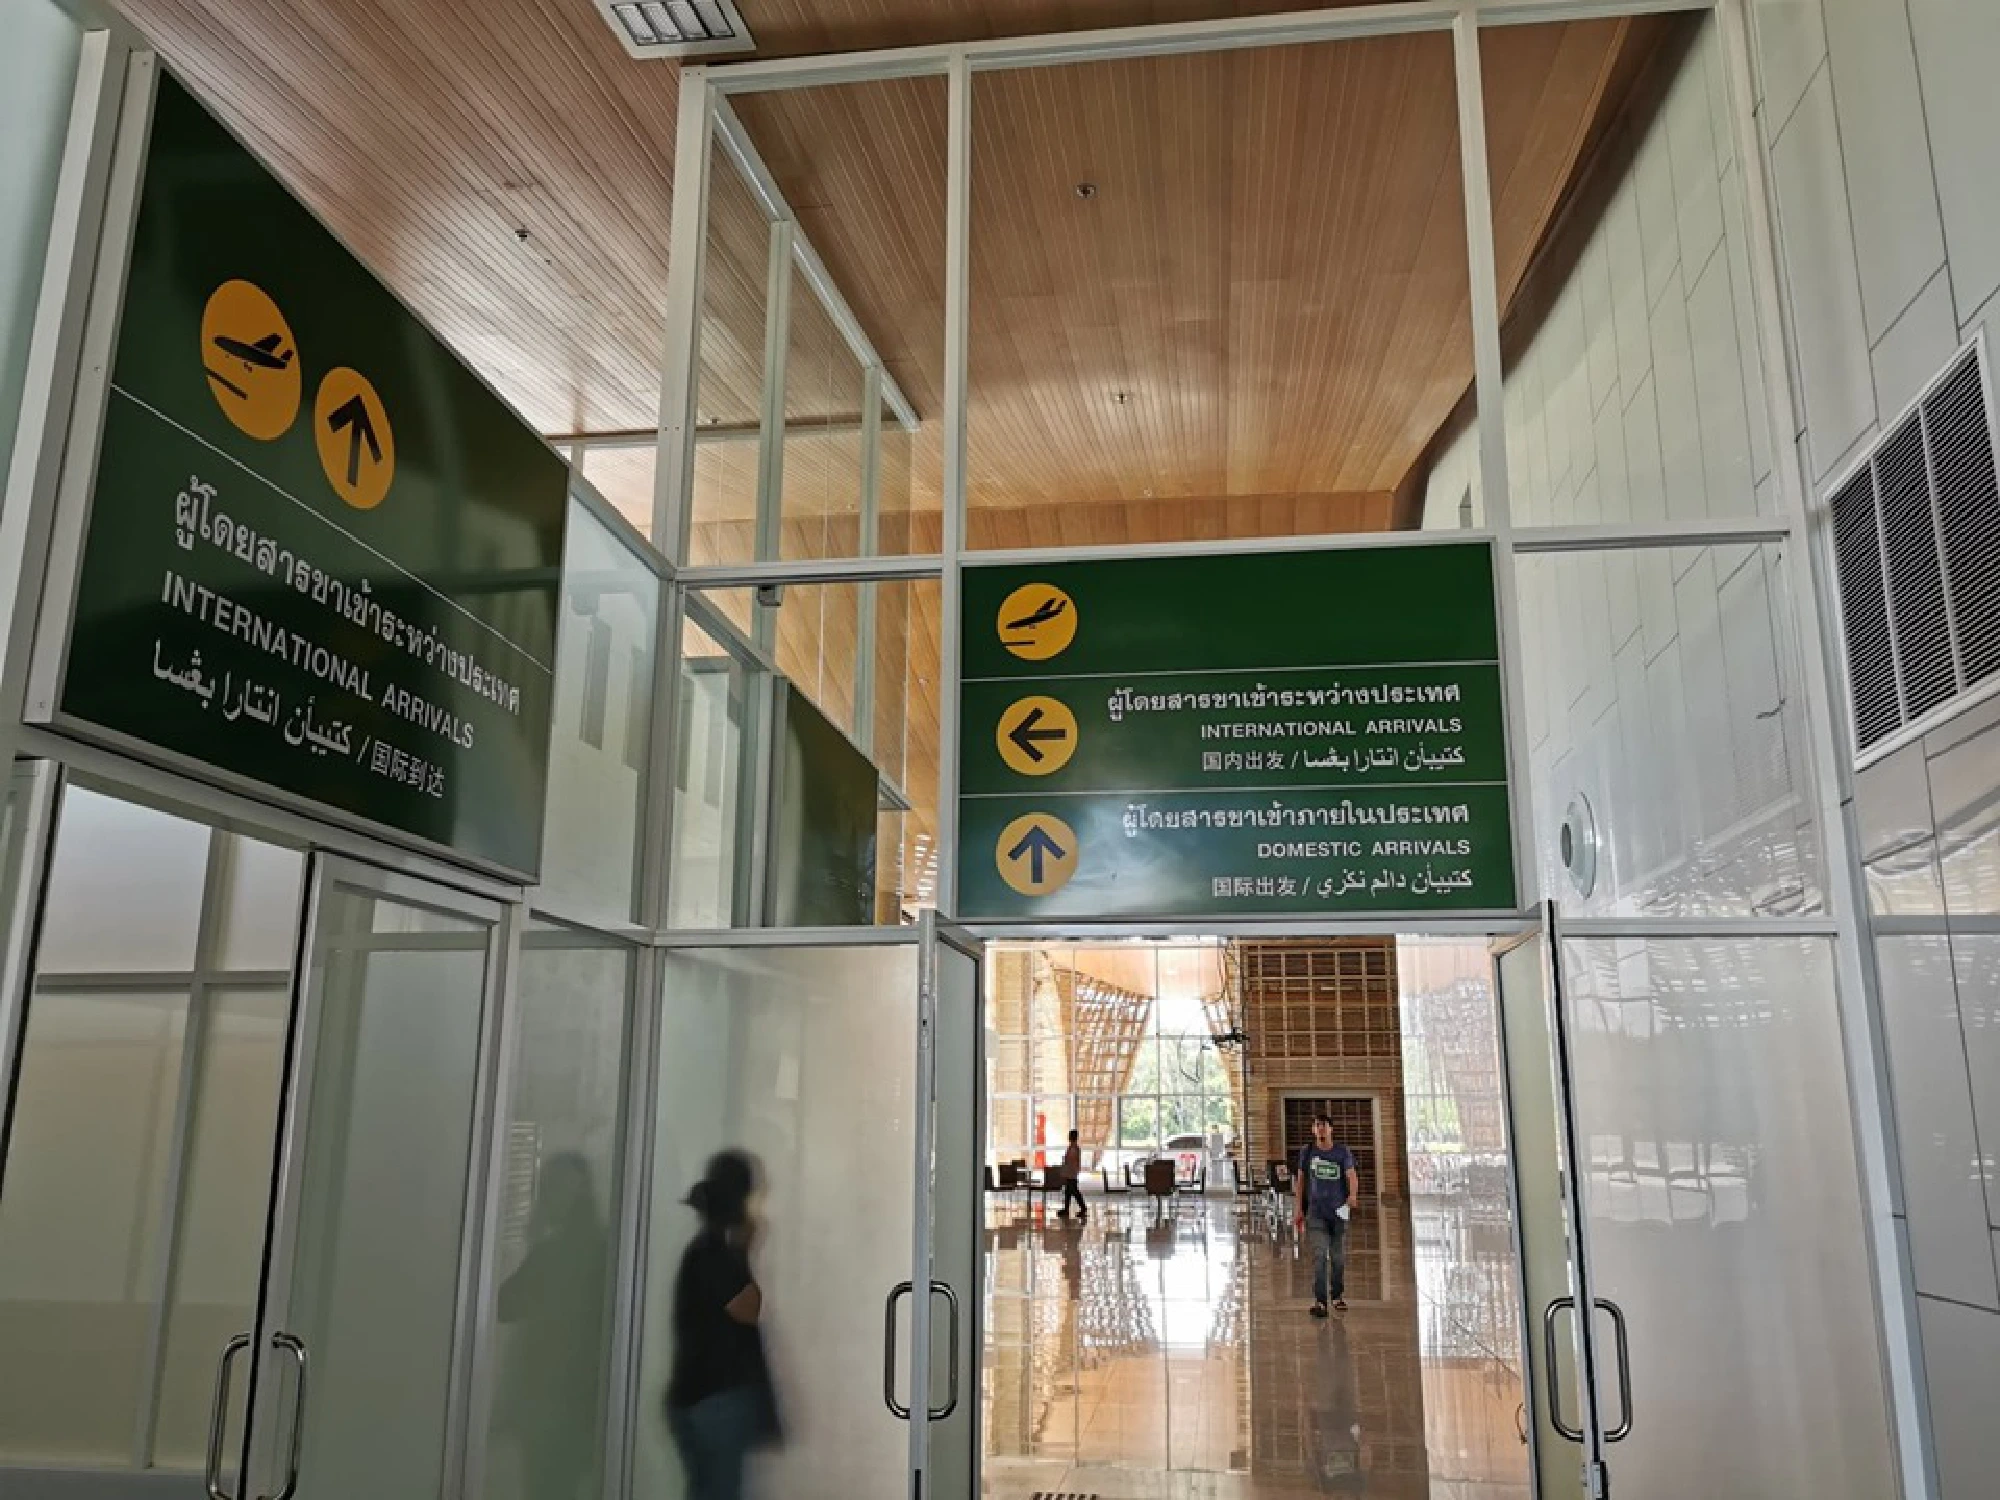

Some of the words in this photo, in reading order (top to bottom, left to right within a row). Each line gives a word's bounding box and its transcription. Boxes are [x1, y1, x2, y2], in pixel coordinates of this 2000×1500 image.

[175, 474, 520, 716] ผู้โดยสารขาเข้าระหว่างประเทศ
[161, 570, 373, 701] INTERNATIONAL
[381, 682, 474, 749] ARRIVALS
[1107, 682, 1461, 721] ผู้โดยสารขาเข้าระหว่างประเทศ
[1201, 720, 1357, 738] INTERNATIONAL
[1364, 716, 1463, 734] ARRIVALS
[1202, 750, 1285, 771] 国内出发
[1122, 800, 1470, 837] ผู้โดยสารขาเข้าภายในประเทศ
[1257, 841, 1363, 859] DOMESTIC
[1370, 839, 1472, 857] ARRIVALS
[1212, 876, 1297, 897] 国际出发
